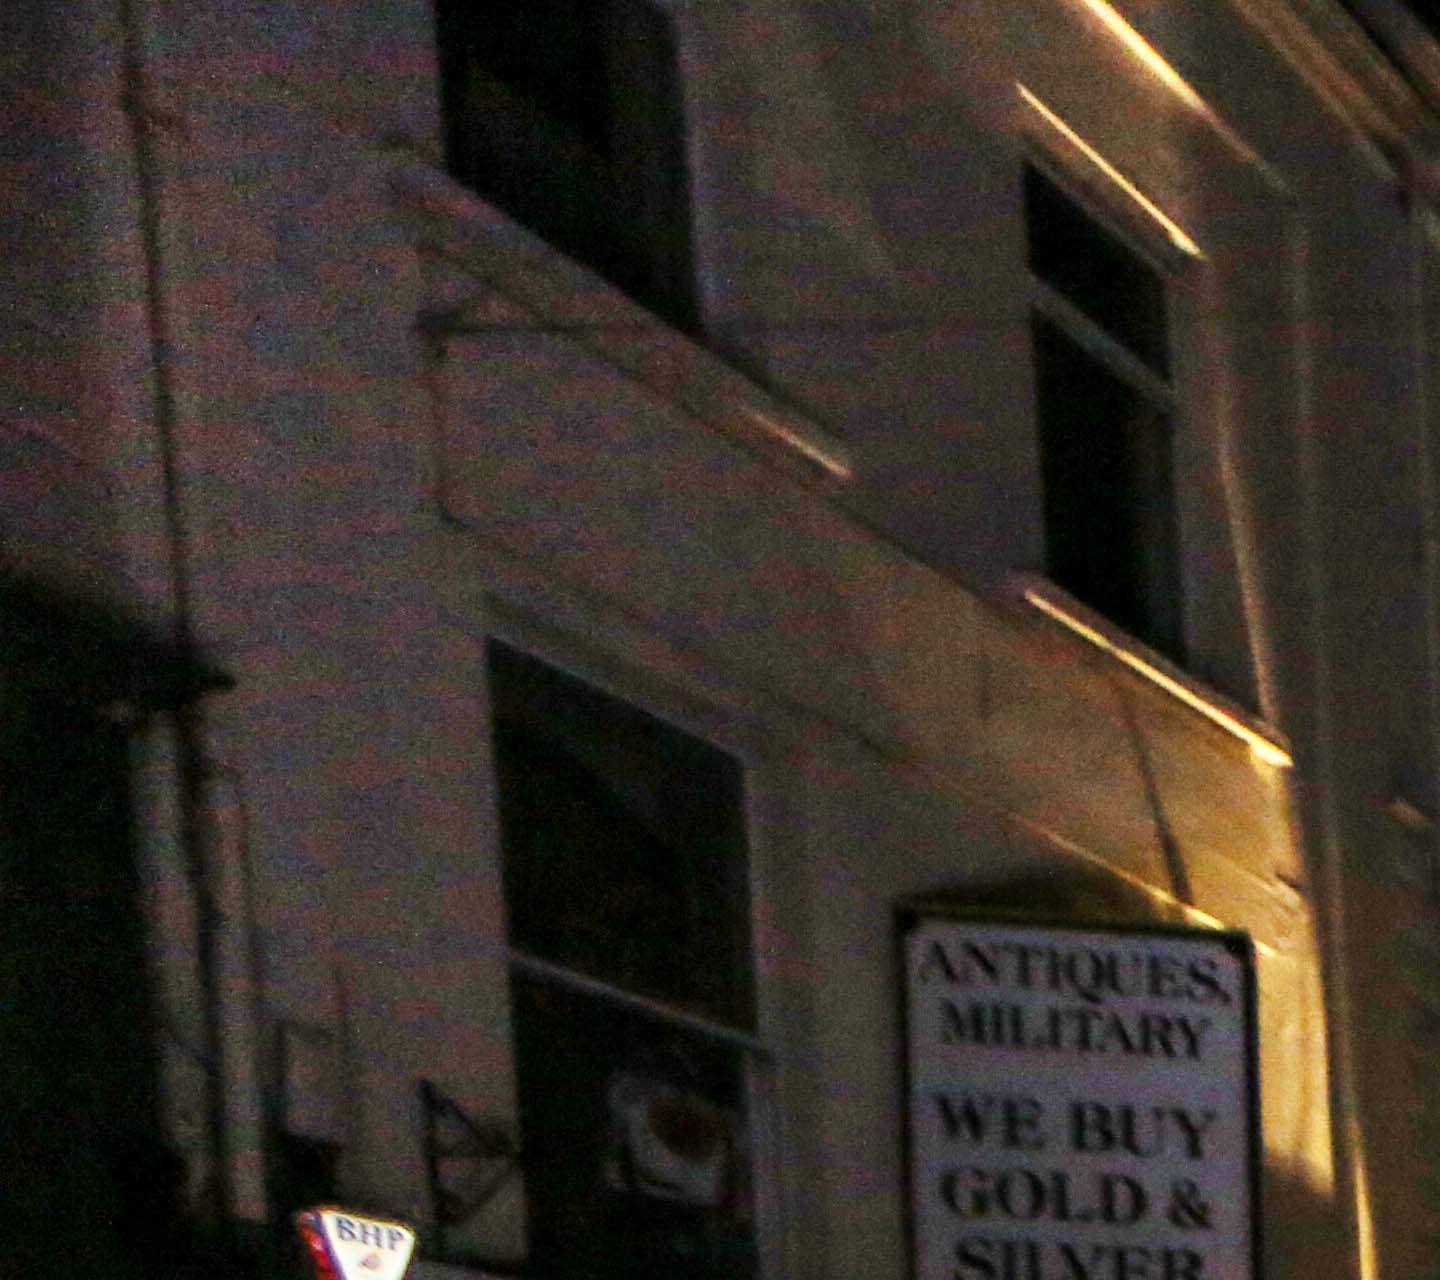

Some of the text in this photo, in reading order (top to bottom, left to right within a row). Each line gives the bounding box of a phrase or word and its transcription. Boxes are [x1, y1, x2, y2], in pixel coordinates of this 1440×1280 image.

[940, 1000, 1212, 1058] MILITARY
[932, 1090, 1216, 1161] WE BUY
[939, 1167, 1214, 1231] GOLD &
